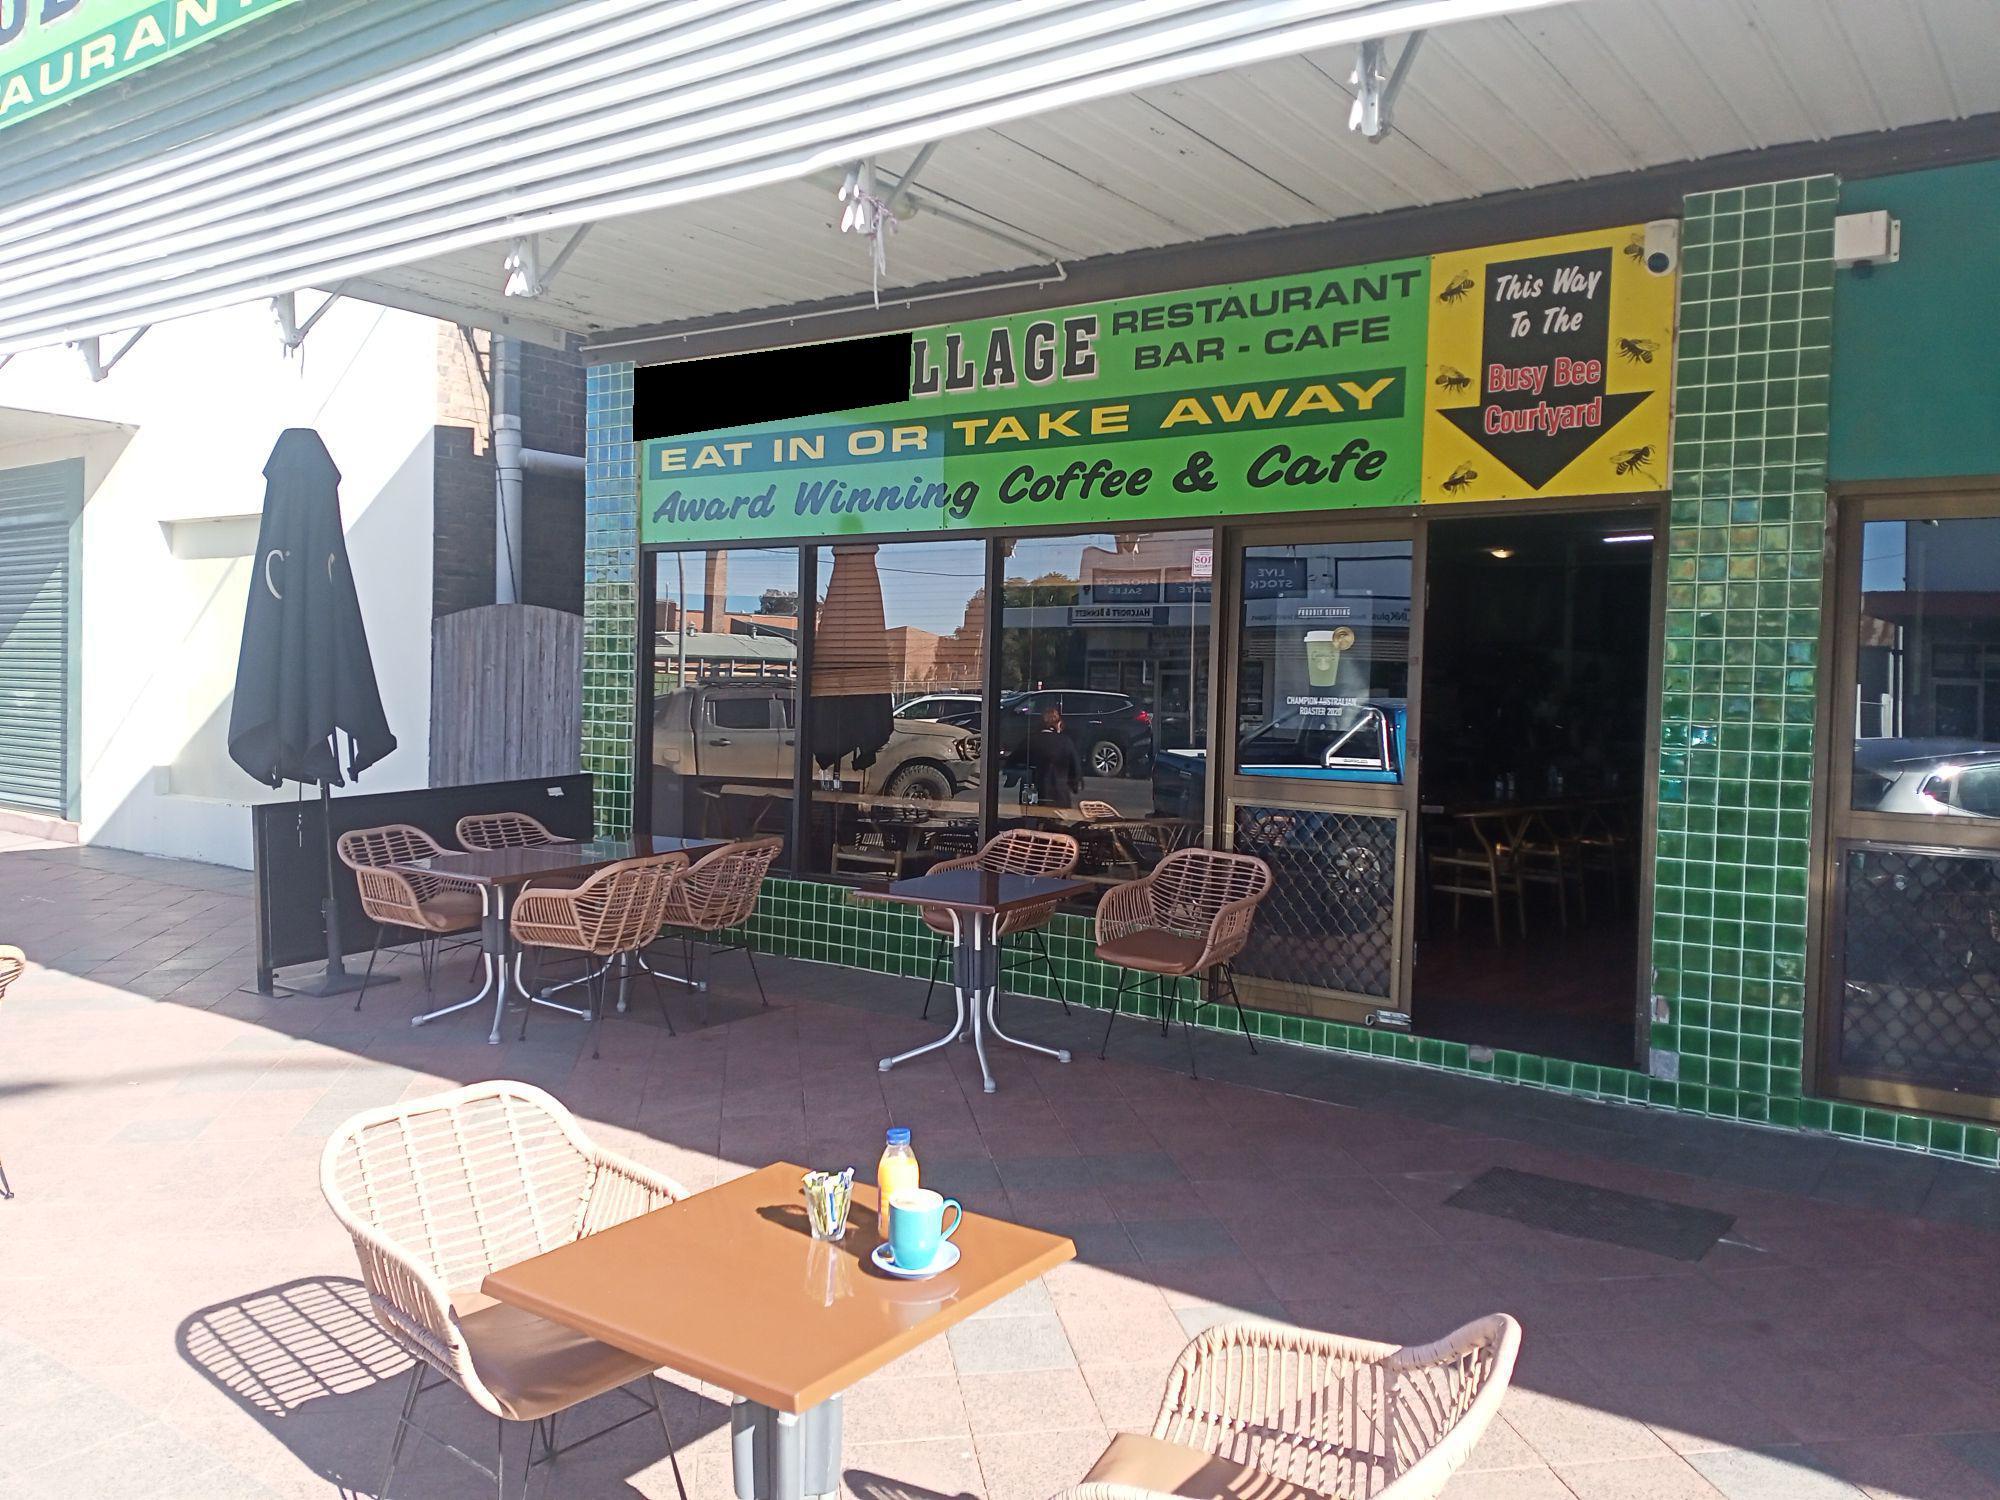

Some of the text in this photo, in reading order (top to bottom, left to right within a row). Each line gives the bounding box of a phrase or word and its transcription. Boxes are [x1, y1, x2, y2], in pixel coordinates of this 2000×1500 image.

[0, 0, 251, 113] AURAN
[1112, 270, 1421, 336] RESTAURANT
[1495, 265, 1602, 302] This Way
[1135, 337, 1224, 370] BAR
[1264, 316, 1390, 352] CAFE
[1510, 306, 1584, 338] To The
[1488, 357, 1601, 395] Busy Bee
[661, 377, 1396, 472] EAT IN OR TAKE AWAY
[1484, 396, 1602, 436] Courtyard
[652, 438, 1388, 524] Award Winning Coffee & Cafe
